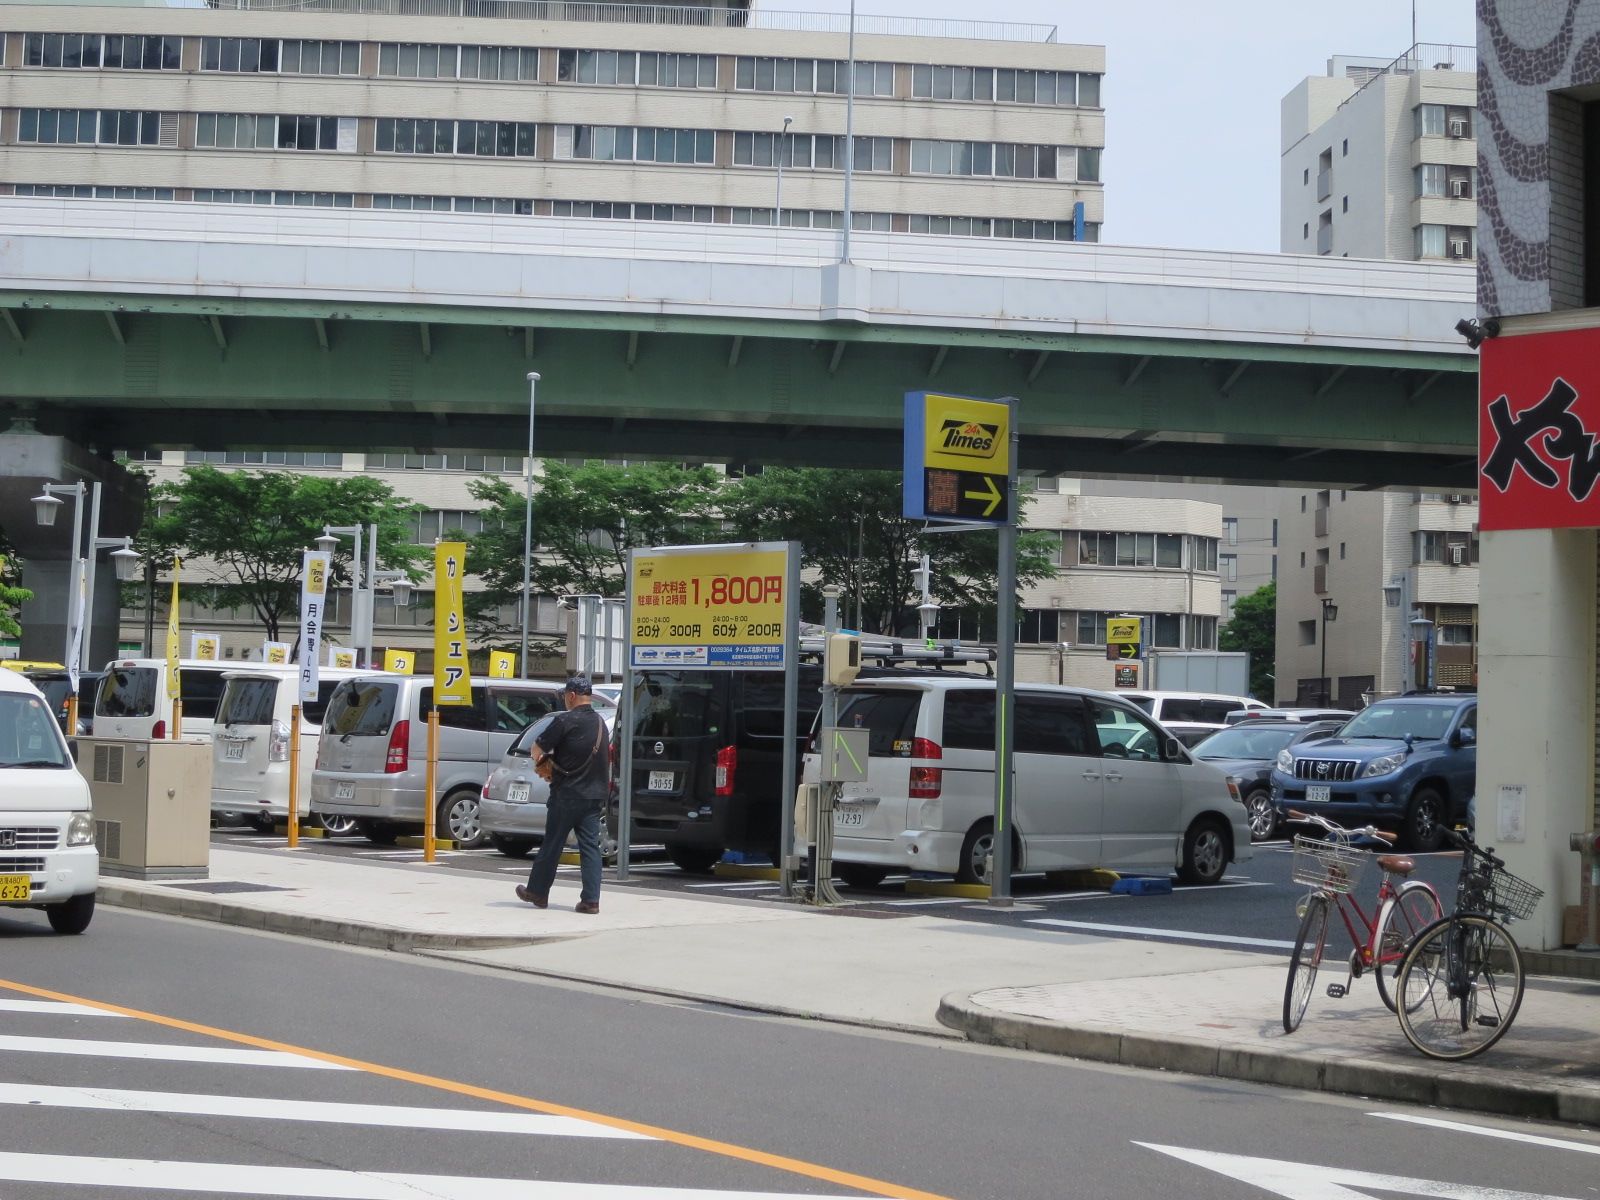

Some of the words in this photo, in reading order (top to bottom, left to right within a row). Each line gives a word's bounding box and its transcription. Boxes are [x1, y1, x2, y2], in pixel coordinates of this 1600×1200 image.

[942, 426, 993, 451] Times
[638, 595, 687, 606] 駐車後12時間
[653, 581, 687, 594] 最大料金
[691, 576, 782, 608] 1,800円
[445, 557, 463, 688] カーシェア
[395, 657, 406, 670] カ
